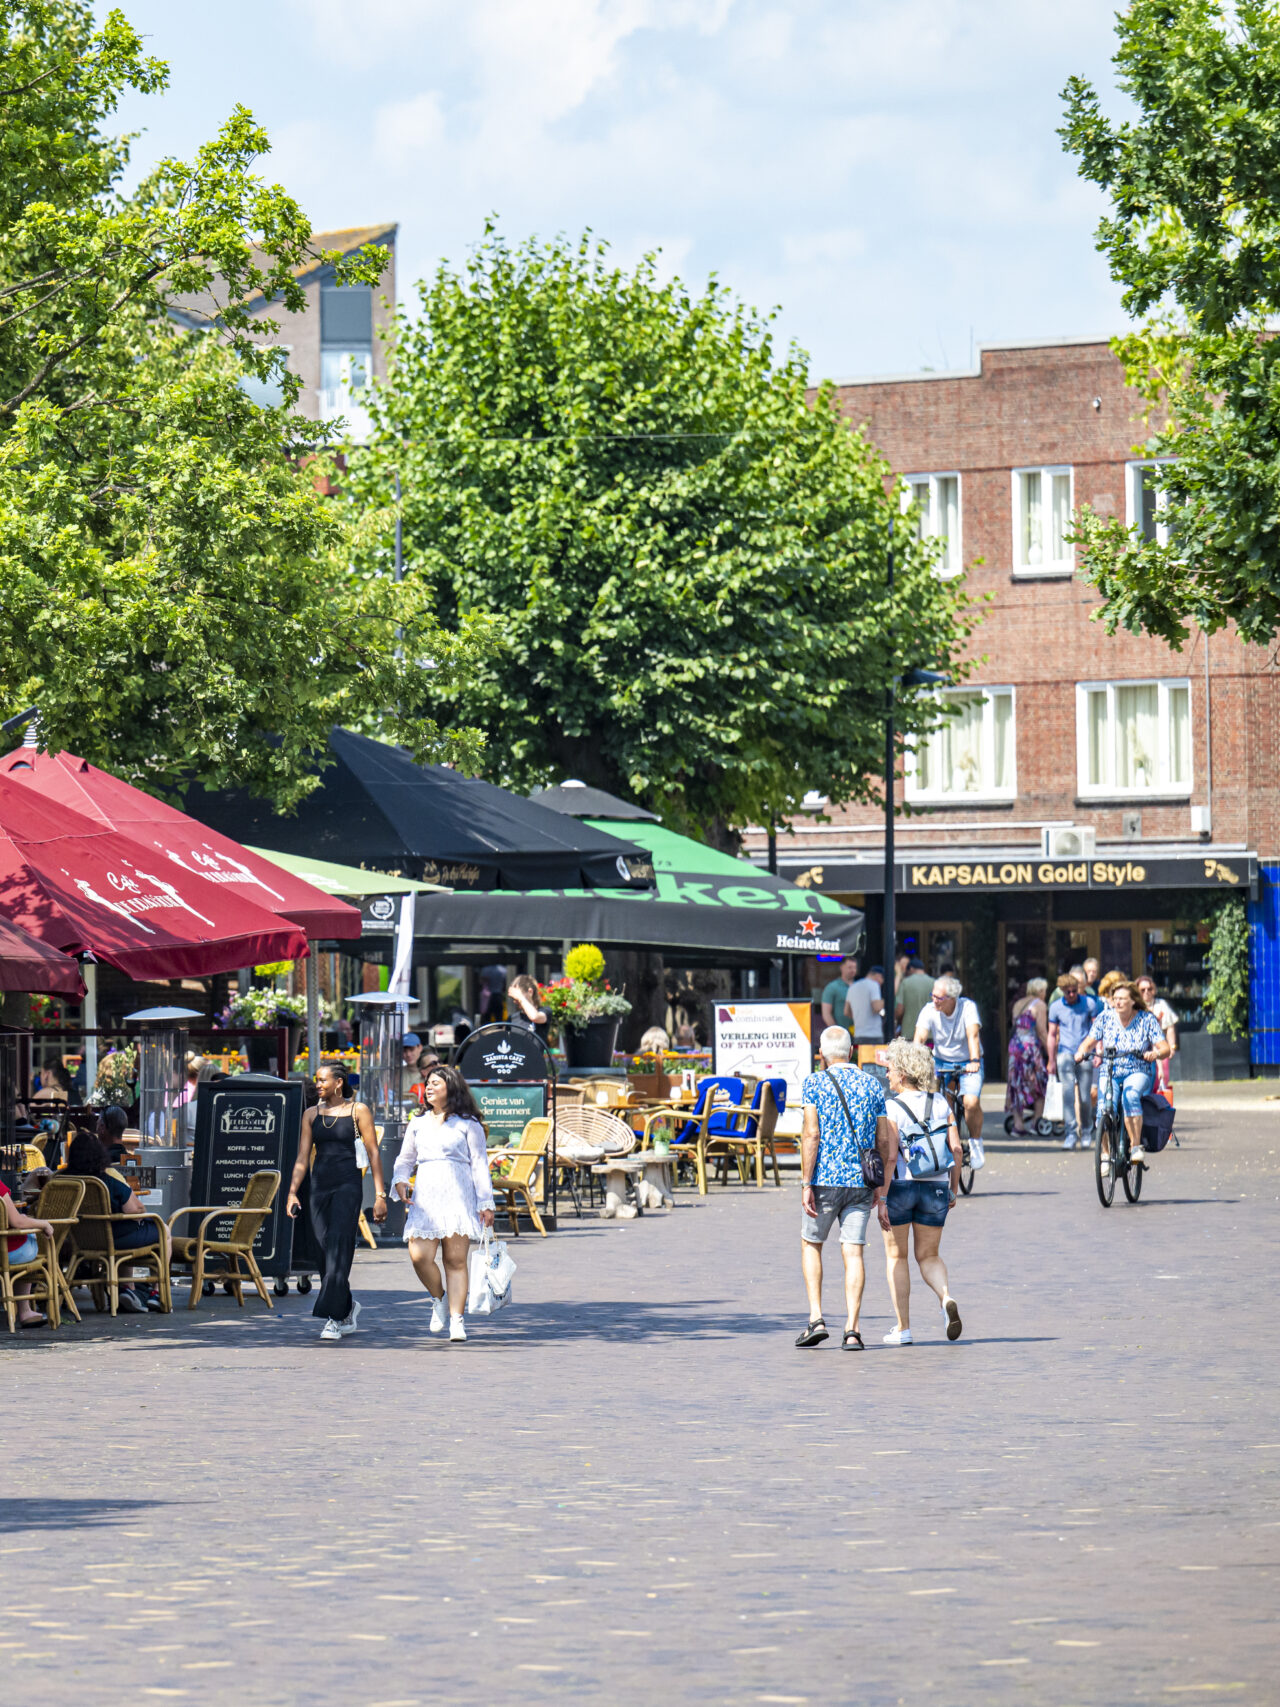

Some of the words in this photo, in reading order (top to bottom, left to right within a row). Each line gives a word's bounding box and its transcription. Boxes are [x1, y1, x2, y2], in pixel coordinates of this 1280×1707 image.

[911, 864, 1033, 885] KAPSALON
[1037, 863, 1087, 883] Gold
[1093, 862, 1146, 886] Style
[776, 934, 840, 951] Heineken
[720, 1032, 769, 1041] VERLENG
[772, 1032, 797, 1040] HIER
[720, 1041, 733, 1049] OF
[737, 1041, 764, 1049] STAP
[766, 1041, 795, 1049] OVER
[480, 1096, 508, 1106] Geniet
[509, 1097, 525, 1106] van
[481, 1107, 495, 1115] der
[496, 1107, 531, 1116] moment
